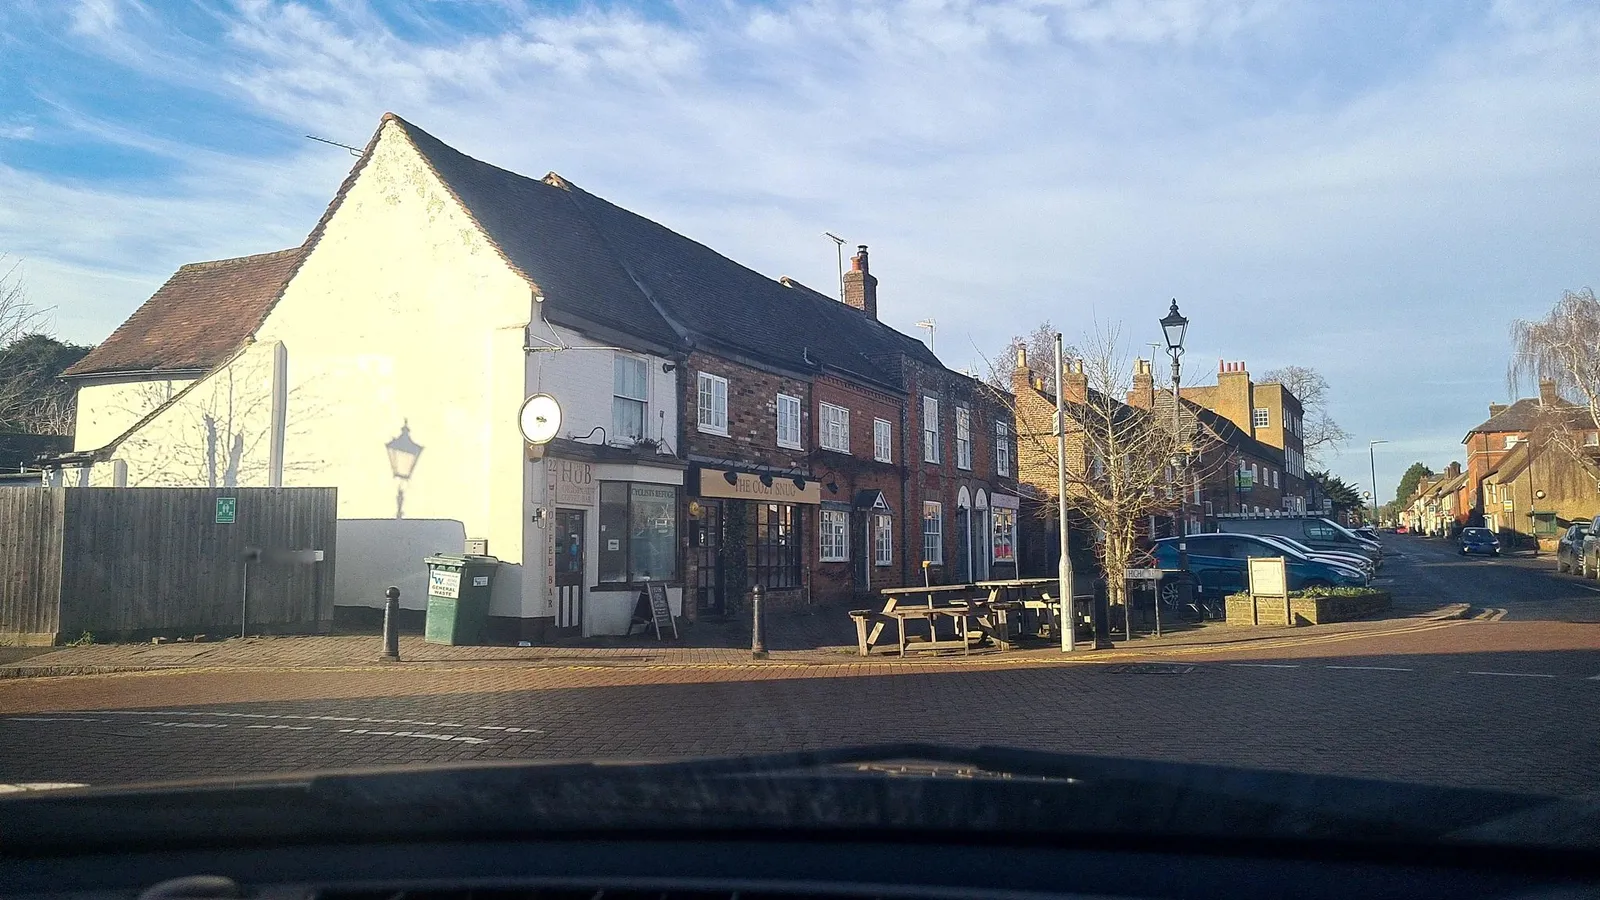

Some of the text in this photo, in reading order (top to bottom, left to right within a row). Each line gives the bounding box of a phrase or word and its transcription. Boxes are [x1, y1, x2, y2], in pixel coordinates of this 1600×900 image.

[548, 459, 557, 472] 22
[562, 461, 592, 485] HUB
[735, 478, 751, 493] THE
[775, 482, 796, 497] SNUG
[431, 584, 456, 593] GENERAL
